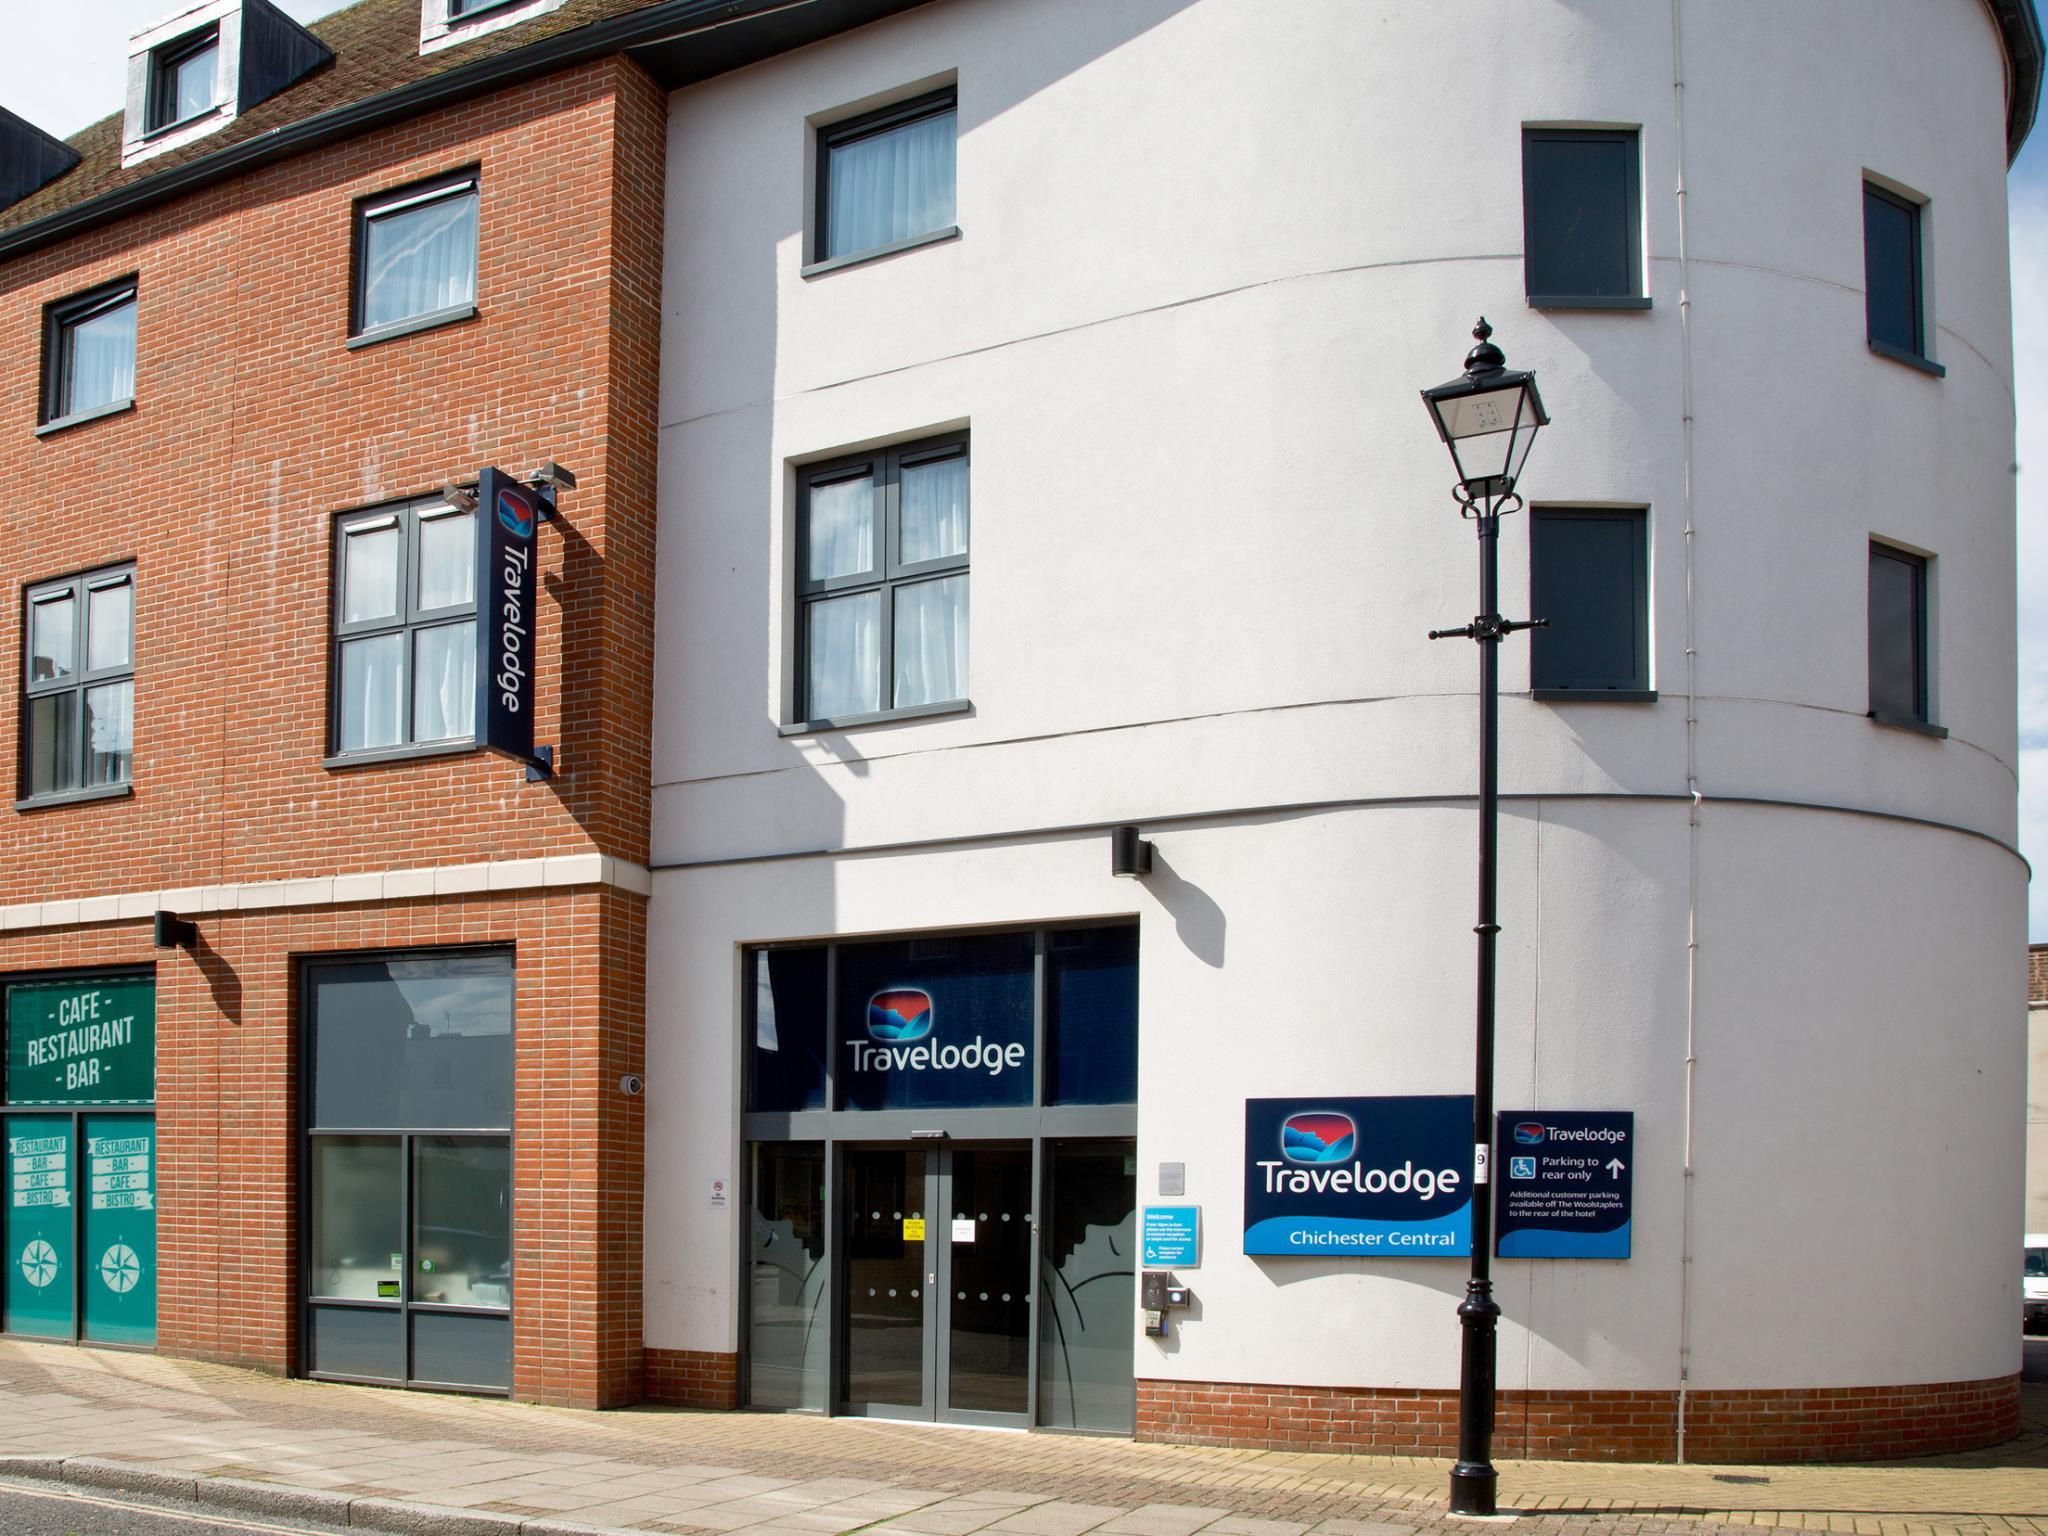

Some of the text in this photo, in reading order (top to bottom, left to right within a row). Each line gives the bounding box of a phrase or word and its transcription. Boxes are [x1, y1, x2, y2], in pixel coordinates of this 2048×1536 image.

[497, 545, 528, 713] Travelodge
[59, 991, 101, 1027] CAFE
[27, 1015, 135, 1068] RESTAURANT
[846, 1035, 1026, 1076] Travelodge
[66, 1057, 101, 1091] BAR
[1545, 1127, 1626, 1144] Travelodge
[15, 1137, 64, 1154] RESTAURANT
[94, 1138, 147, 1155] RESTAURANT
[31, 1157, 48, 1170] BAR
[111, 1158, 130, 1172] BAR
[1477, 1153, 1486, 1166] 9
[1542, 1156, 1600, 1169] Parking to
[29, 1173, 50, 1187] CAFE
[109, 1175, 132, 1189] CAFE
[1256, 1160, 1460, 1201] Travelodge
[1542, 1169, 1593, 1182] rear only
[26, 1190, 54, 1205] BISTRO
[105, 1193, 136, 1207] BISTRO
[1509, 1190, 1620, 1201] Additional customer parking
[1509, 1200, 1624, 1210] available off The Woolstaplers
[1575, 1210, 1597, 1218] hotel
[1289, 1230, 1455, 1246] Chichester Central
